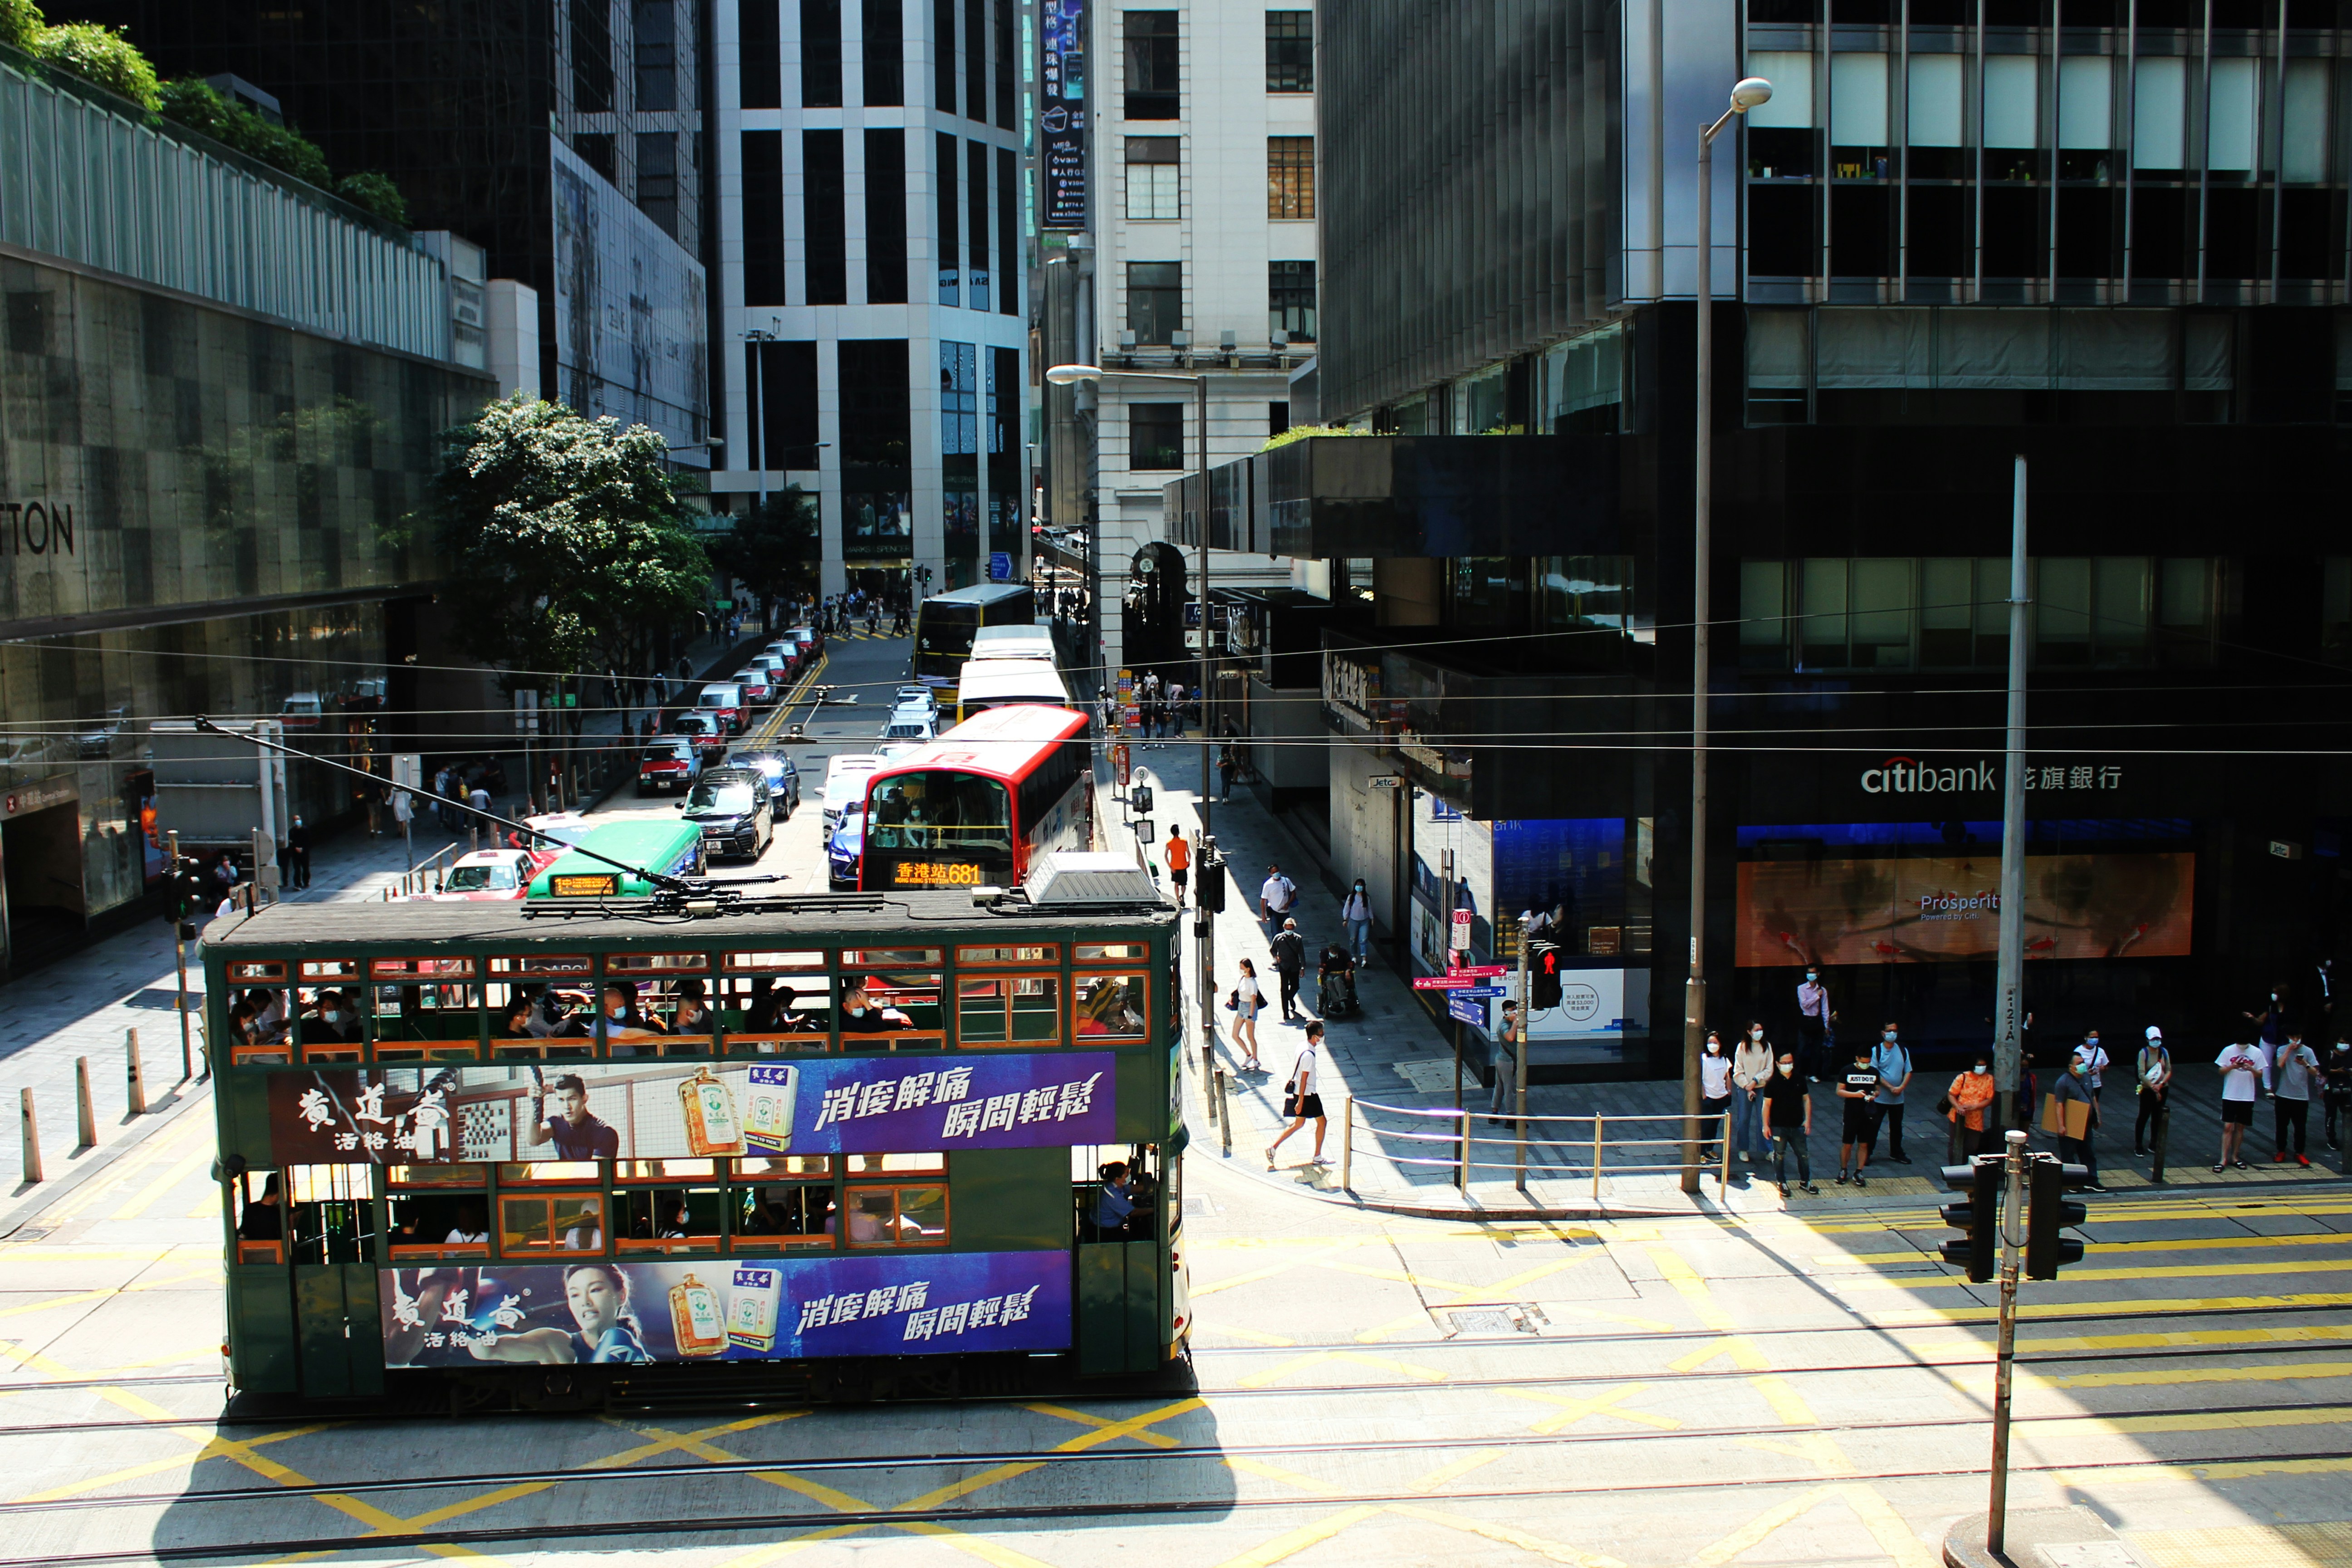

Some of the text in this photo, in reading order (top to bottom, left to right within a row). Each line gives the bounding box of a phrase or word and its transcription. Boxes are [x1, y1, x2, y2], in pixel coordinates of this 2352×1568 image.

[876, 545, 911, 553] SPENCER
[1861, 757, 1995, 793] citibank
[897, 862, 946, 878] 香港站
[949, 864, 981, 884] 681
[1170, 931, 1180, 961] 120
[299, 1083, 450, 1132] 黃道益
[814, 1066, 974, 1132] 消痠解痛
[941, 1071, 1103, 1139] 瞬間輕鬆
[334, 1131, 417, 1151] 活絡油
[392, 1289, 526, 1332] 黃道益
[795, 1281, 930, 1336] 消痠解痛
[903, 1284, 1040, 1341] 瞬間輕鬆
[424, 1330, 499, 1348] 活絡油
